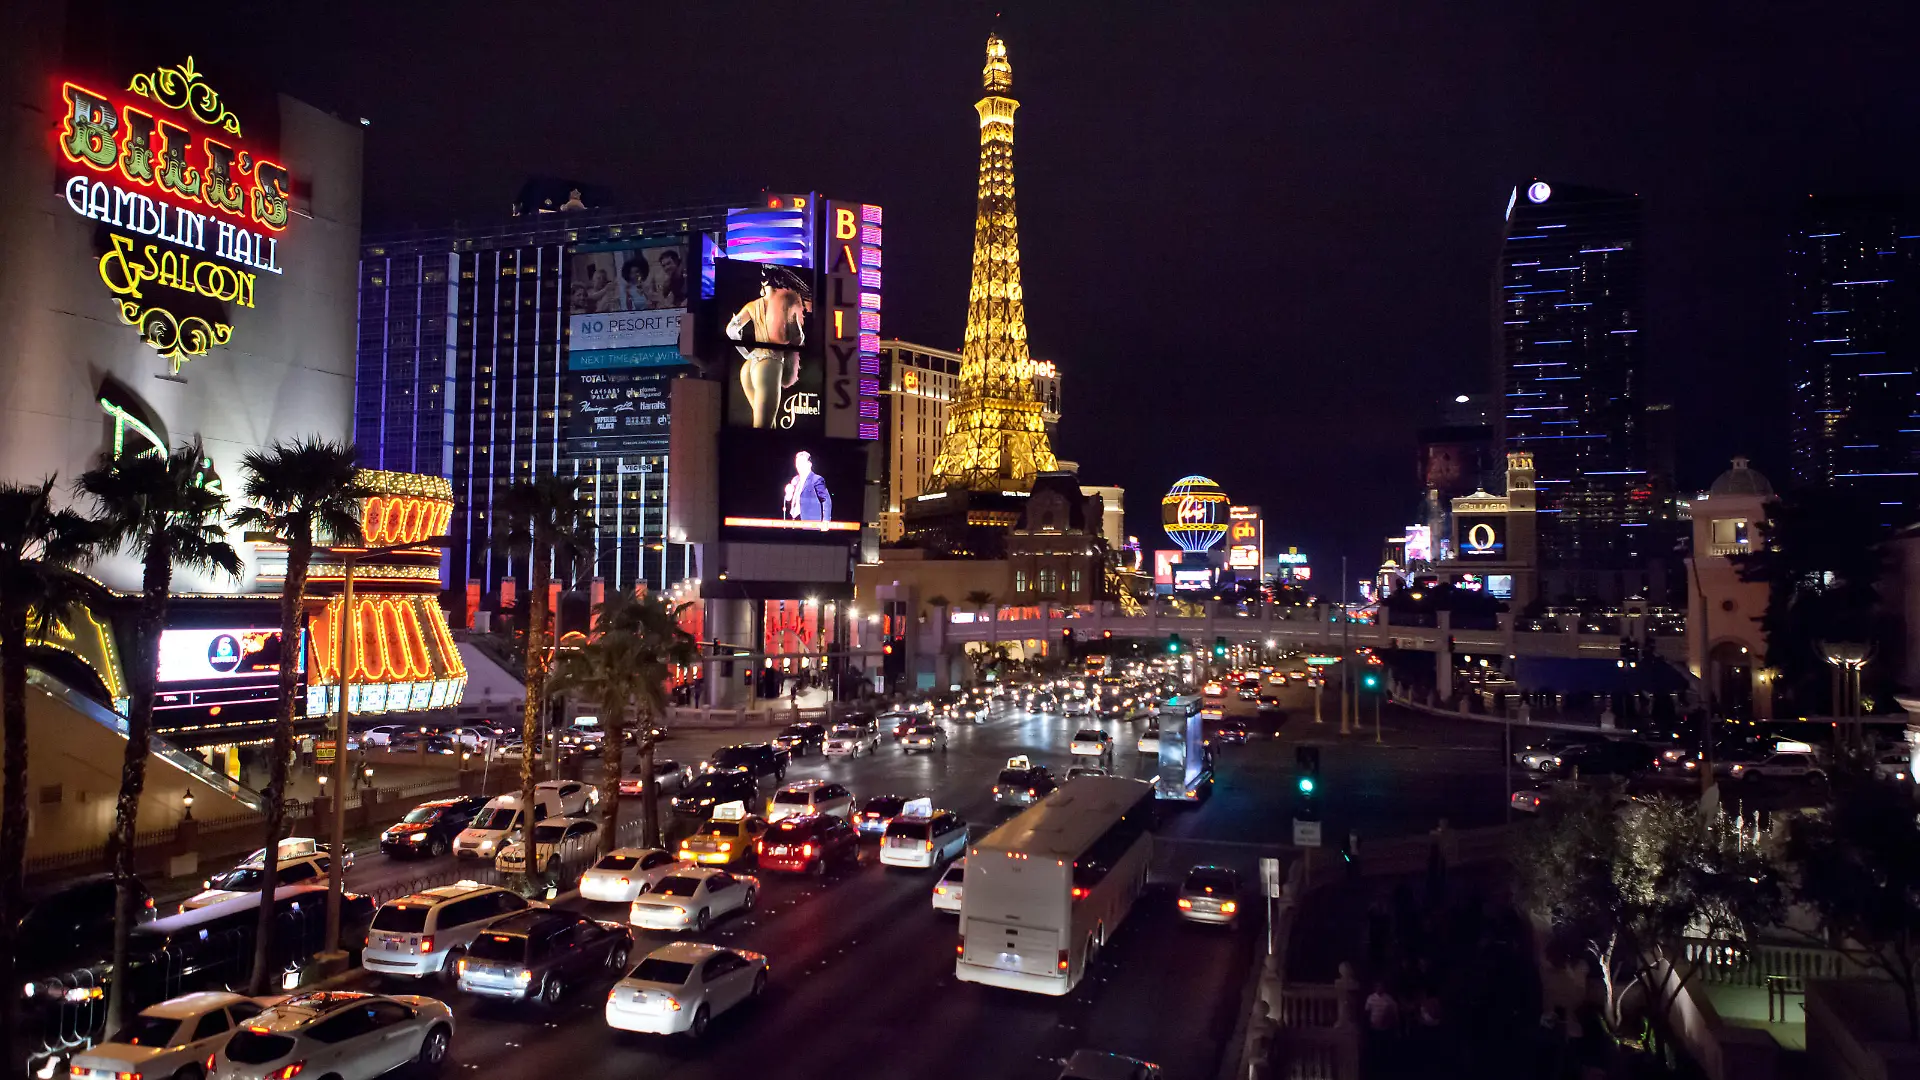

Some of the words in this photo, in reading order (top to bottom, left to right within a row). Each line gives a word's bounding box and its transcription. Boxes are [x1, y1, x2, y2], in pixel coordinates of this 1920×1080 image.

[60, 82, 290, 231] BILL'S
[65, 175, 218, 252] GAMBLIN'
[216, 220, 283, 274] HALL
[99, 233, 146, 299] &
[141, 244, 257, 309] SALOON
[581, 321, 603, 333] NO
[607, 317, 662, 332] RESORT
[581, 355, 604, 364] NEXT
[632, 352, 654, 364] STAY
[658, 351, 683, 361] WITH
[581, 375, 606, 383] TOTAL
[780, 391, 820, 430] Jubilee!
